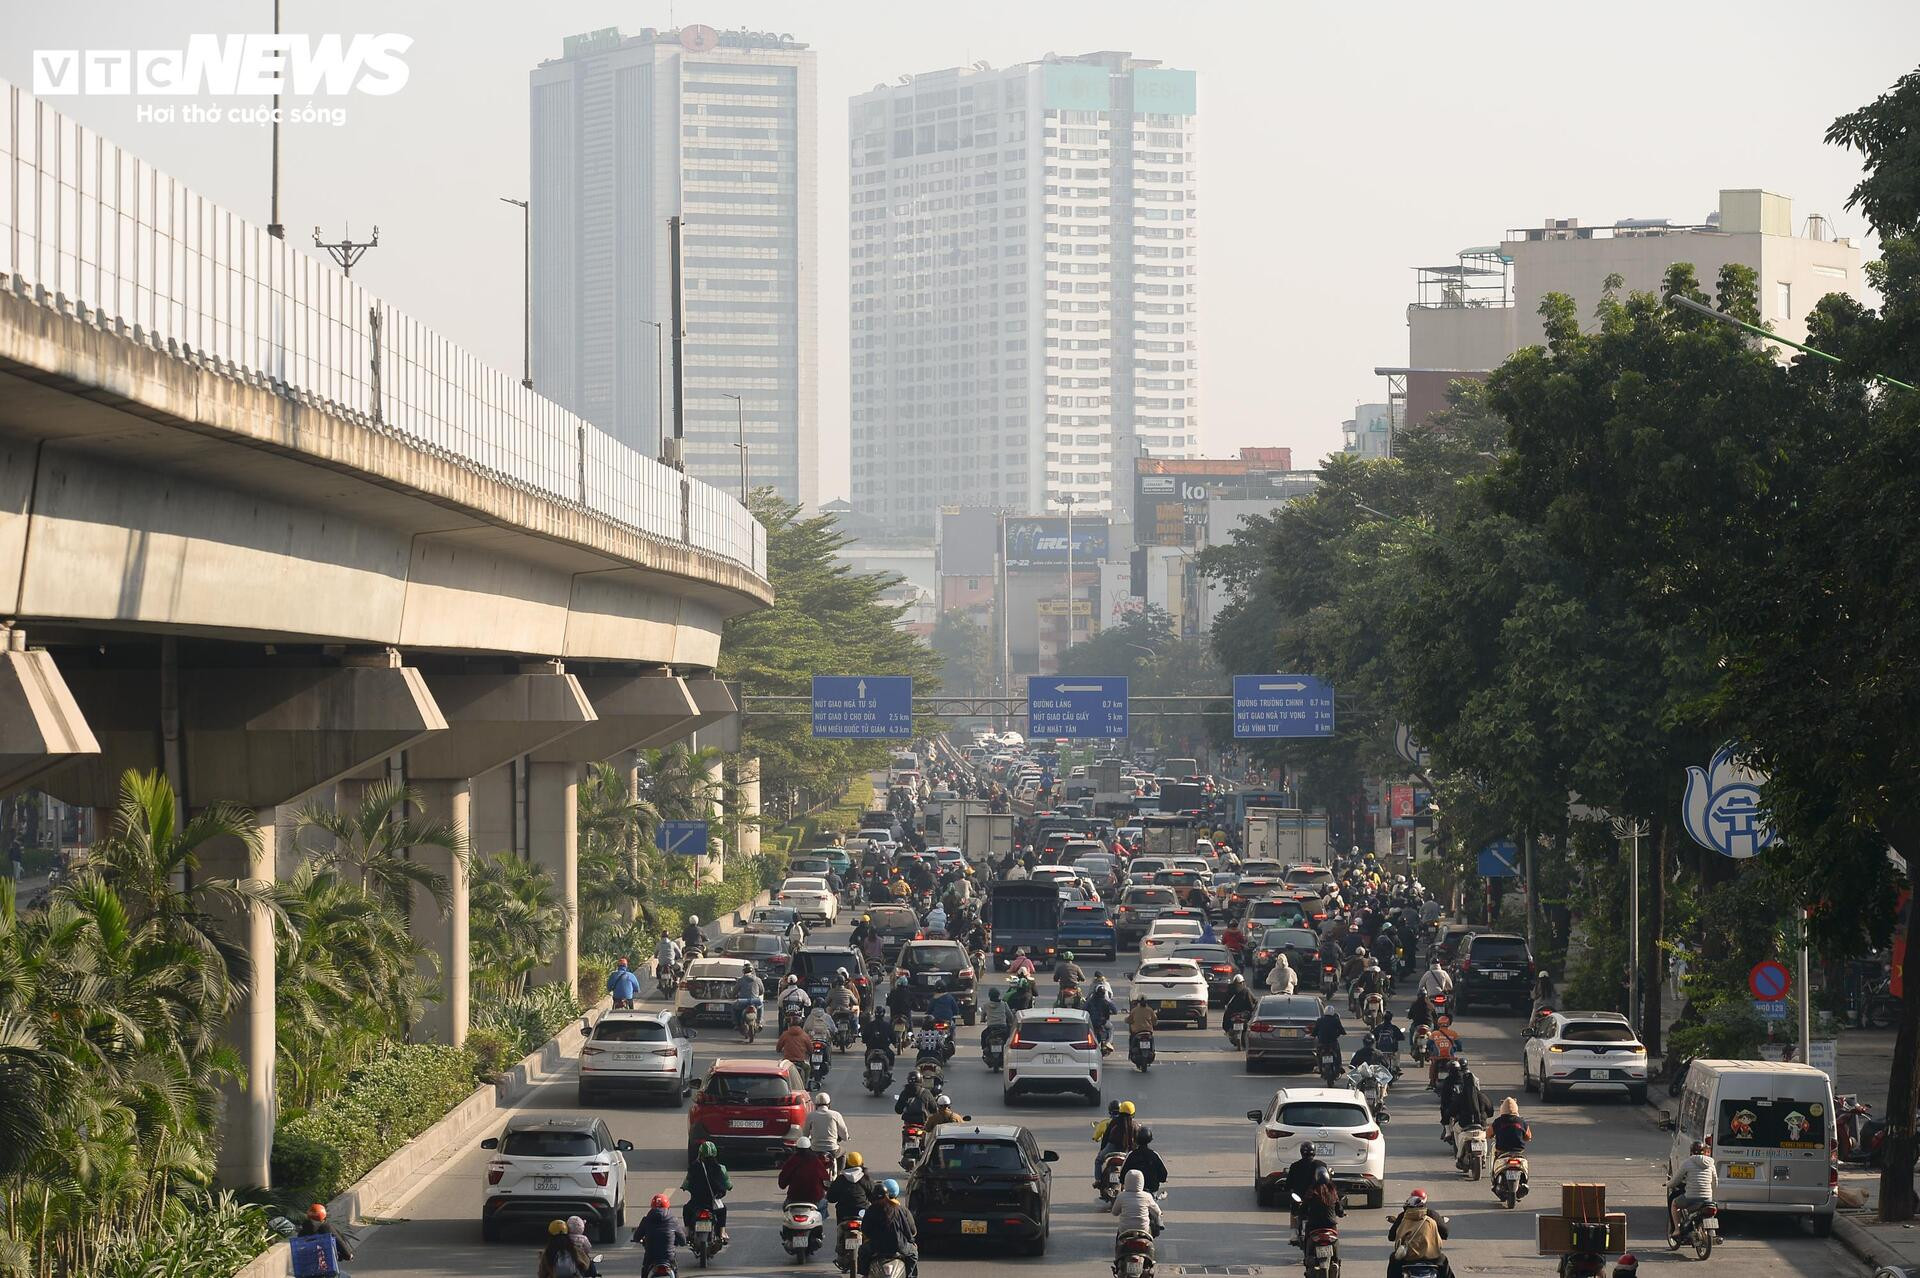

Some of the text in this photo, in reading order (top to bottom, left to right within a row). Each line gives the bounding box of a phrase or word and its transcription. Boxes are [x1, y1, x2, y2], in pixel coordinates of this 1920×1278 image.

[1113, 700, 1123, 708] km
[899, 713, 910, 721] km
[1113, 713, 1123, 721] km
[1320, 711, 1331, 719] km
[899, 725, 910, 733] km
[1113, 725, 1123, 733] km
